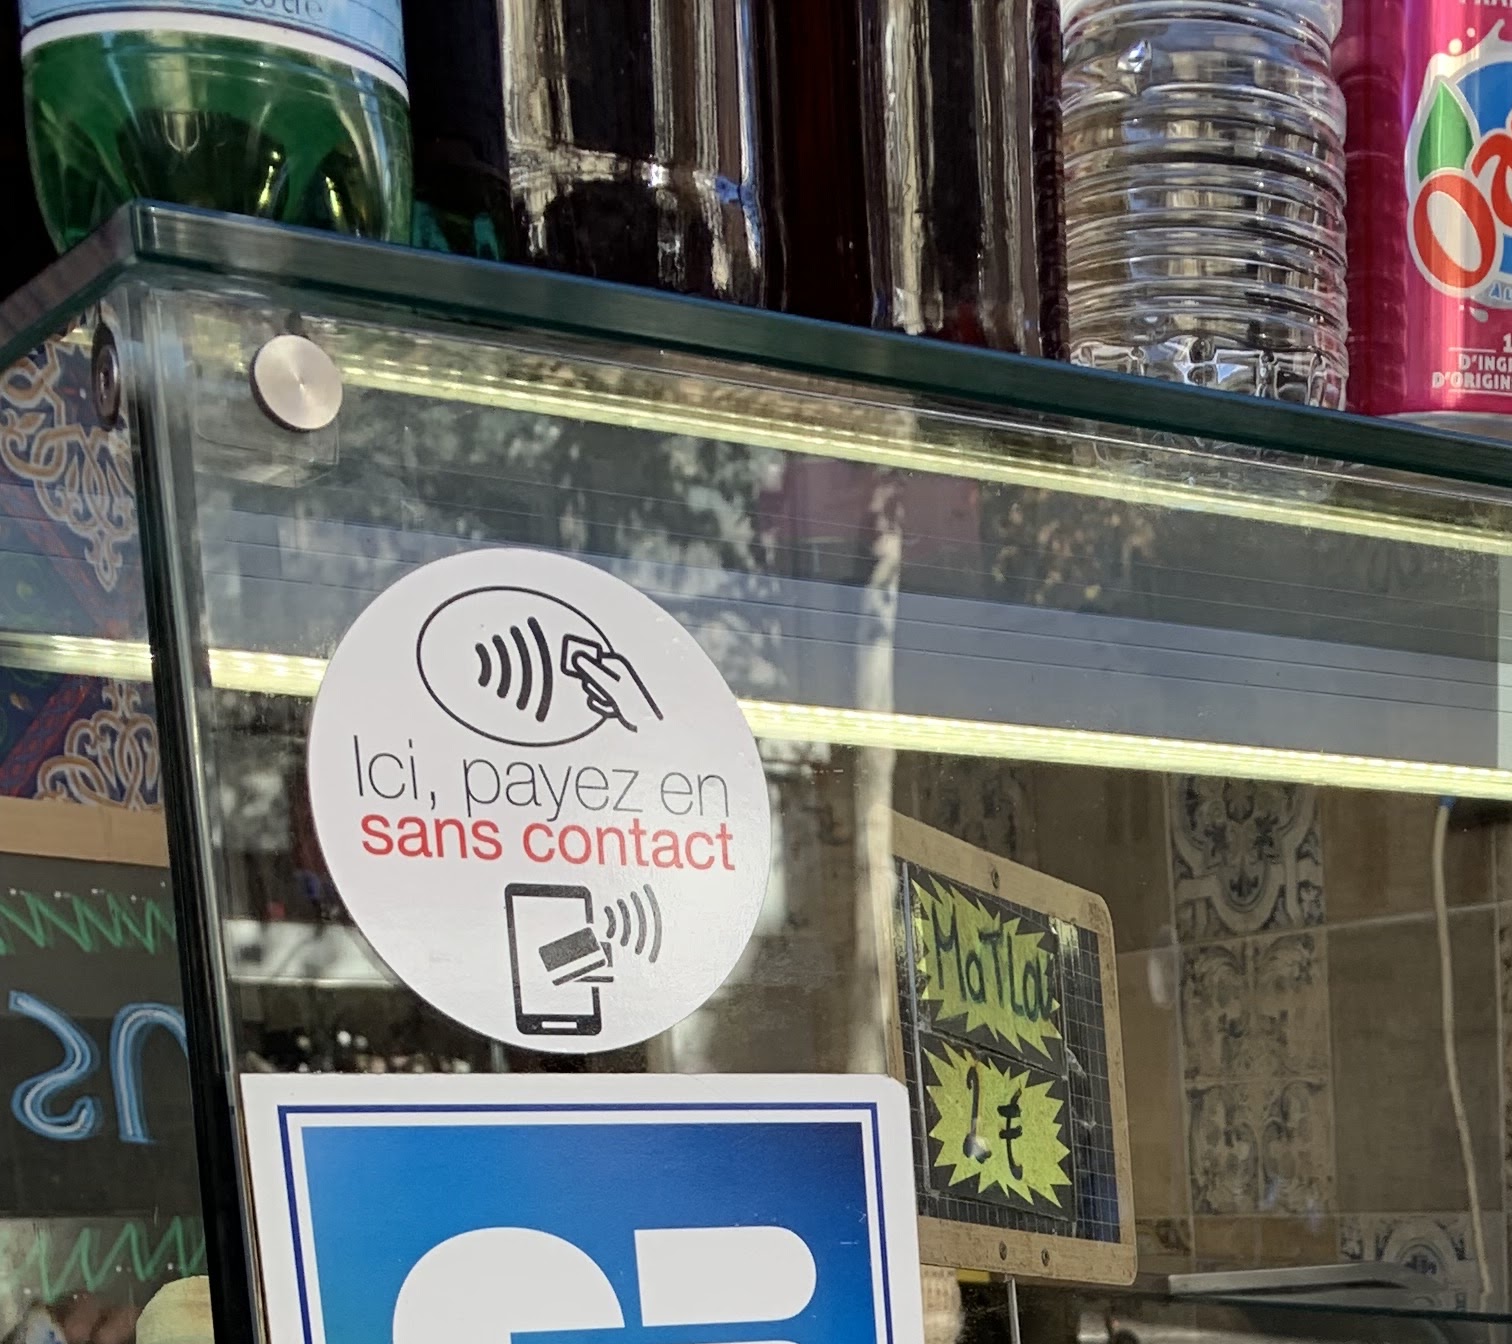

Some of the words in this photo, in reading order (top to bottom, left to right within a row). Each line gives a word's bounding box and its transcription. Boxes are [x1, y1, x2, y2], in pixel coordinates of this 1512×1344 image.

[352, 734, 438, 811] Ici,
[462, 756, 644, 822] payez
[660, 771, 730, 818] en
[361, 813, 504, 861] sans
[522, 816, 737, 871] contact
